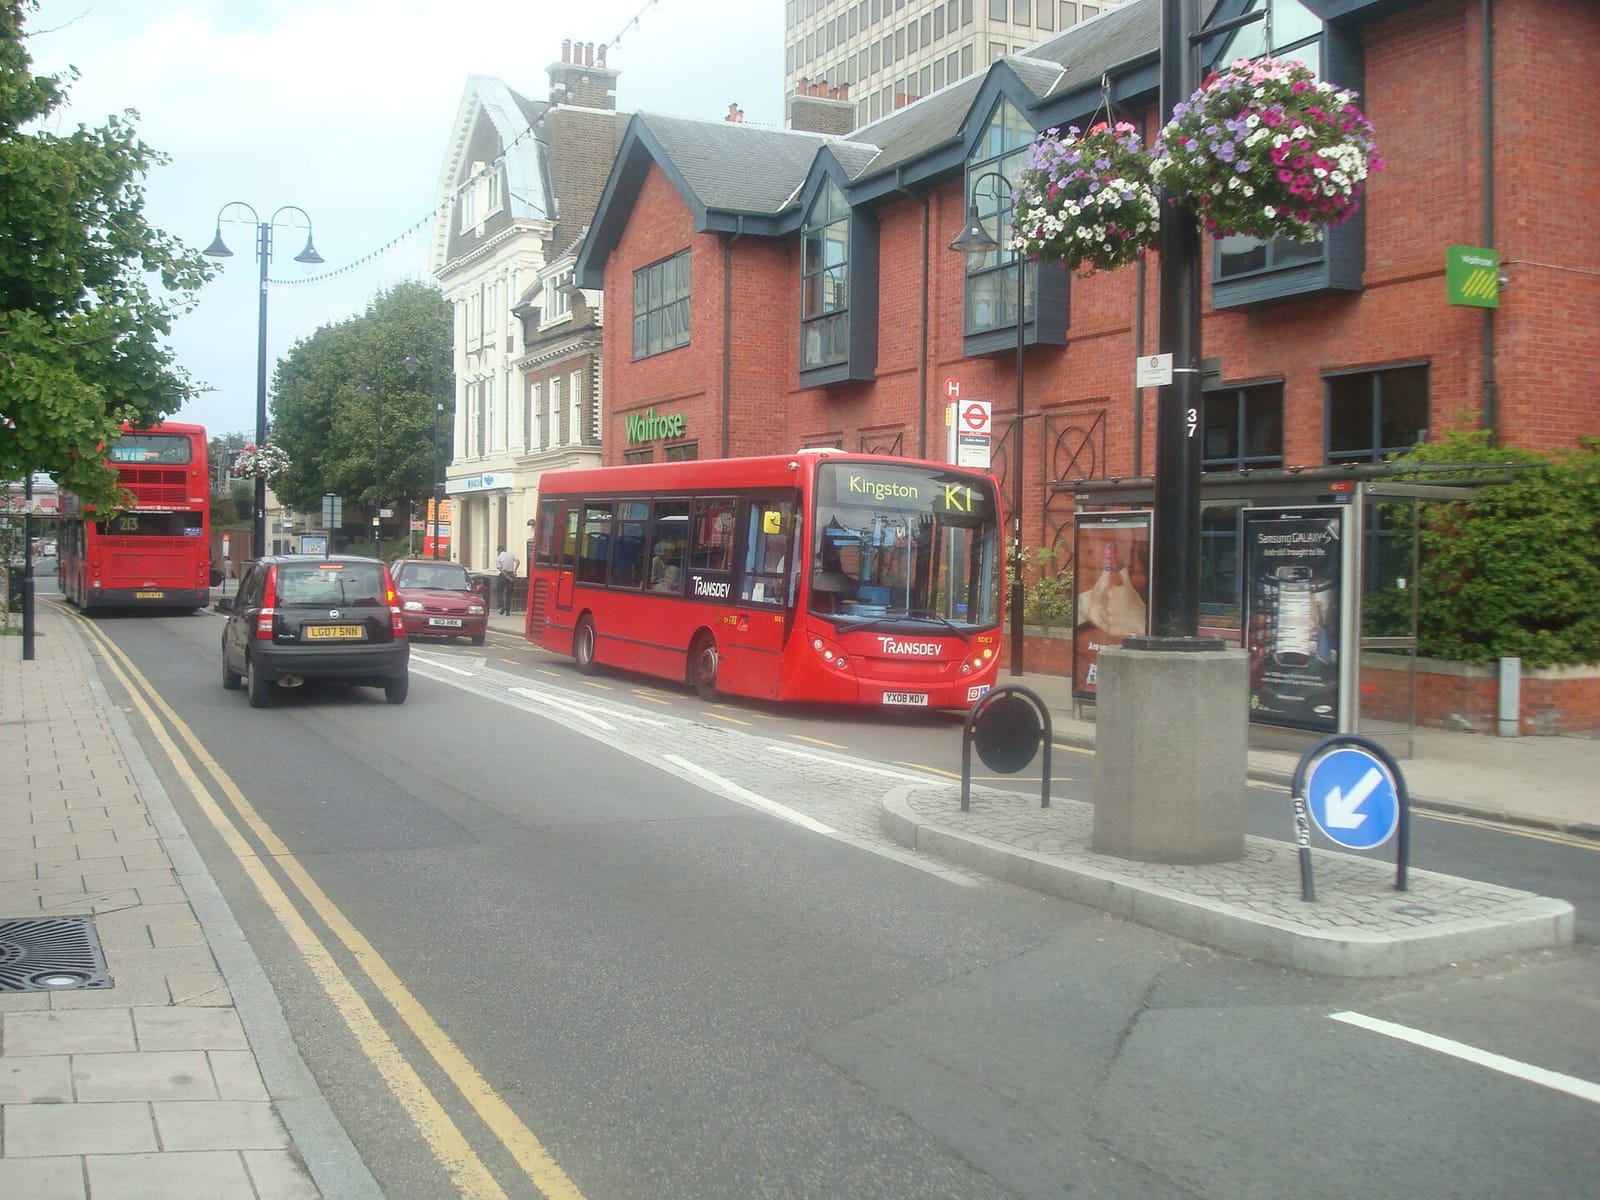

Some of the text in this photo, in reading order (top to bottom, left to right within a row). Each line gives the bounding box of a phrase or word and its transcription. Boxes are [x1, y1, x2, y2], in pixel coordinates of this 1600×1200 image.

[948, 381, 960, 396] H
[625, 407, 687, 445] Waitrose
[849, 475, 972, 512] Kingston K1
[120, 517, 138, 531] 213
[1258, 532, 1292, 546] Samsung
[1292, 532, 1321, 543] GALAXY
[692, 575, 731, 599] TRANSDEV
[311, 626, 358, 637] LG07 SNN
[877, 636, 943, 656] TRANSDEV
[886, 692, 907, 703] YX08
